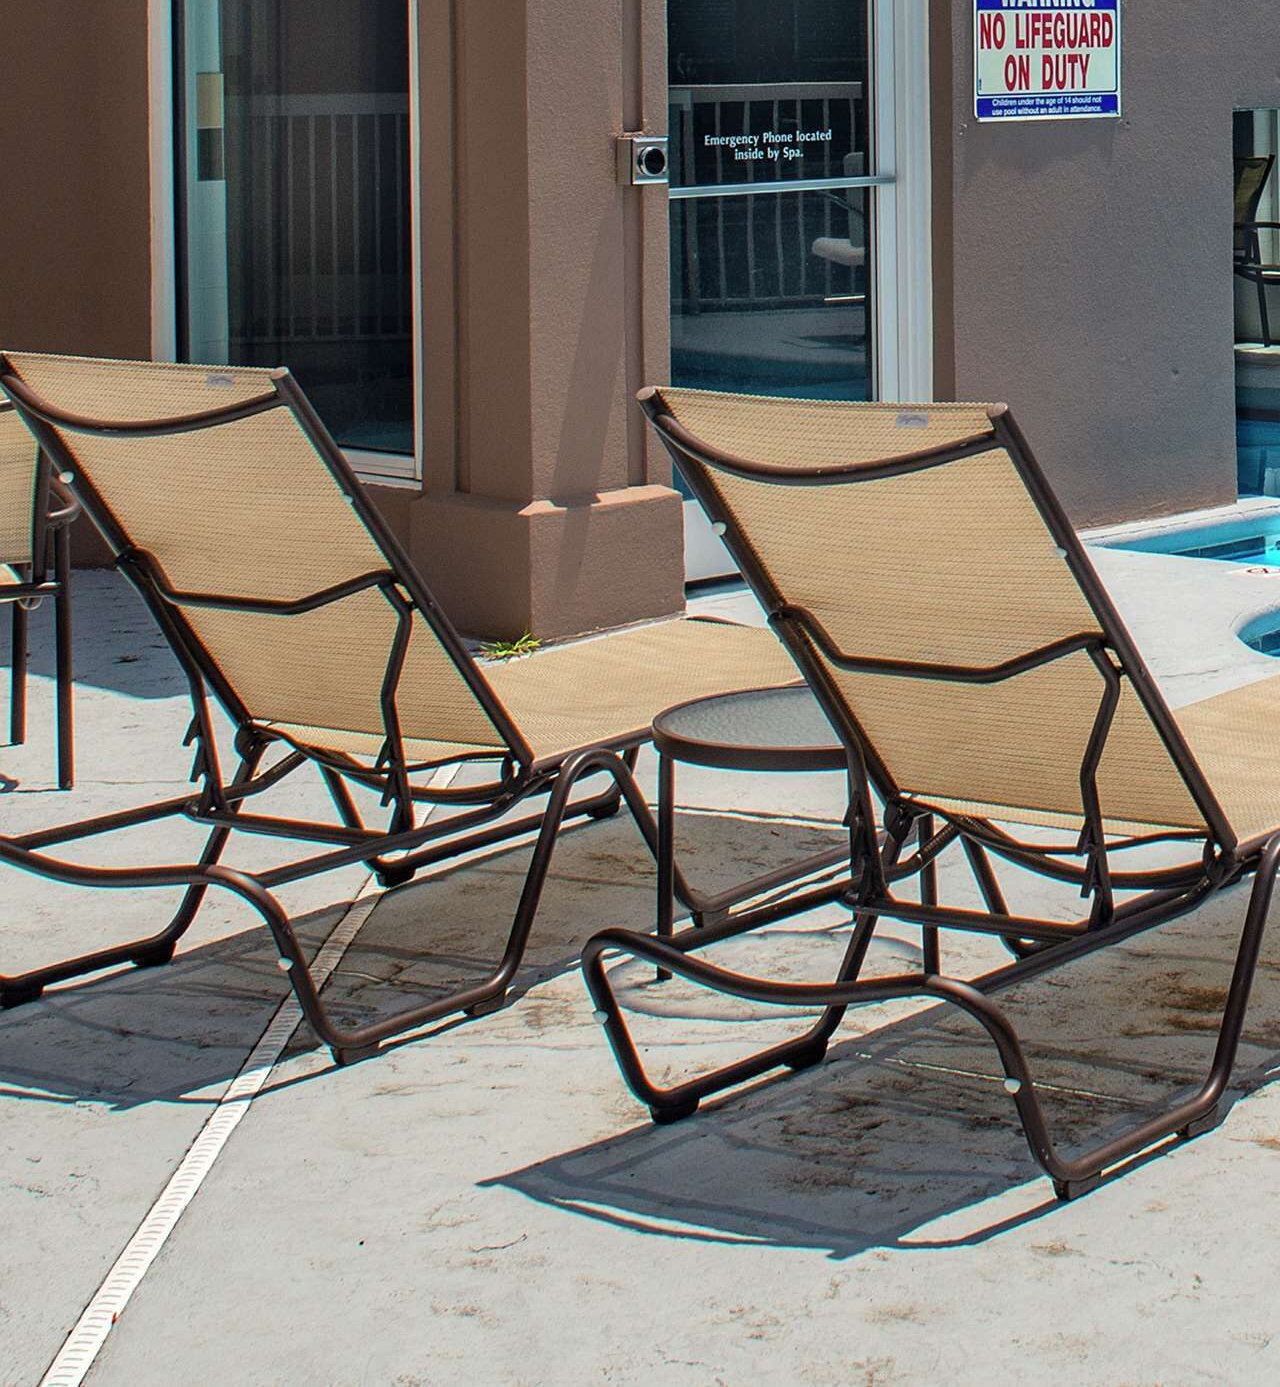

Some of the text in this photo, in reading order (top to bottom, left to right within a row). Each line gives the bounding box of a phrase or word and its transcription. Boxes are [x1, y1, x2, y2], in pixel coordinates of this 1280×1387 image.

[980, 12, 1113, 49] NO LIFEGUARD
[1004, 53, 1090, 91] ON DUTY
[992, 97, 1017, 106] Children
[1018, 98, 1034, 106] under
[1035, 97, 1044, 105] the
[1046, 98, 1056, 106] age
[1057, 96, 1063, 104] of
[1065, 96, 1071, 104] 14
[1072, 96, 1091, 104] should
[992, 108, 1002, 116] use
[1004, 107, 1017, 117] pool
[1018, 107, 1039, 115] without
[1048, 106, 1062, 114] adult
[1064, 105, 1069, 113] in
[1070, 104, 1102, 113] attendance.
[704, 129, 832, 148] Emergency Phone located
[734, 146, 804, 161] inside by Spa.
